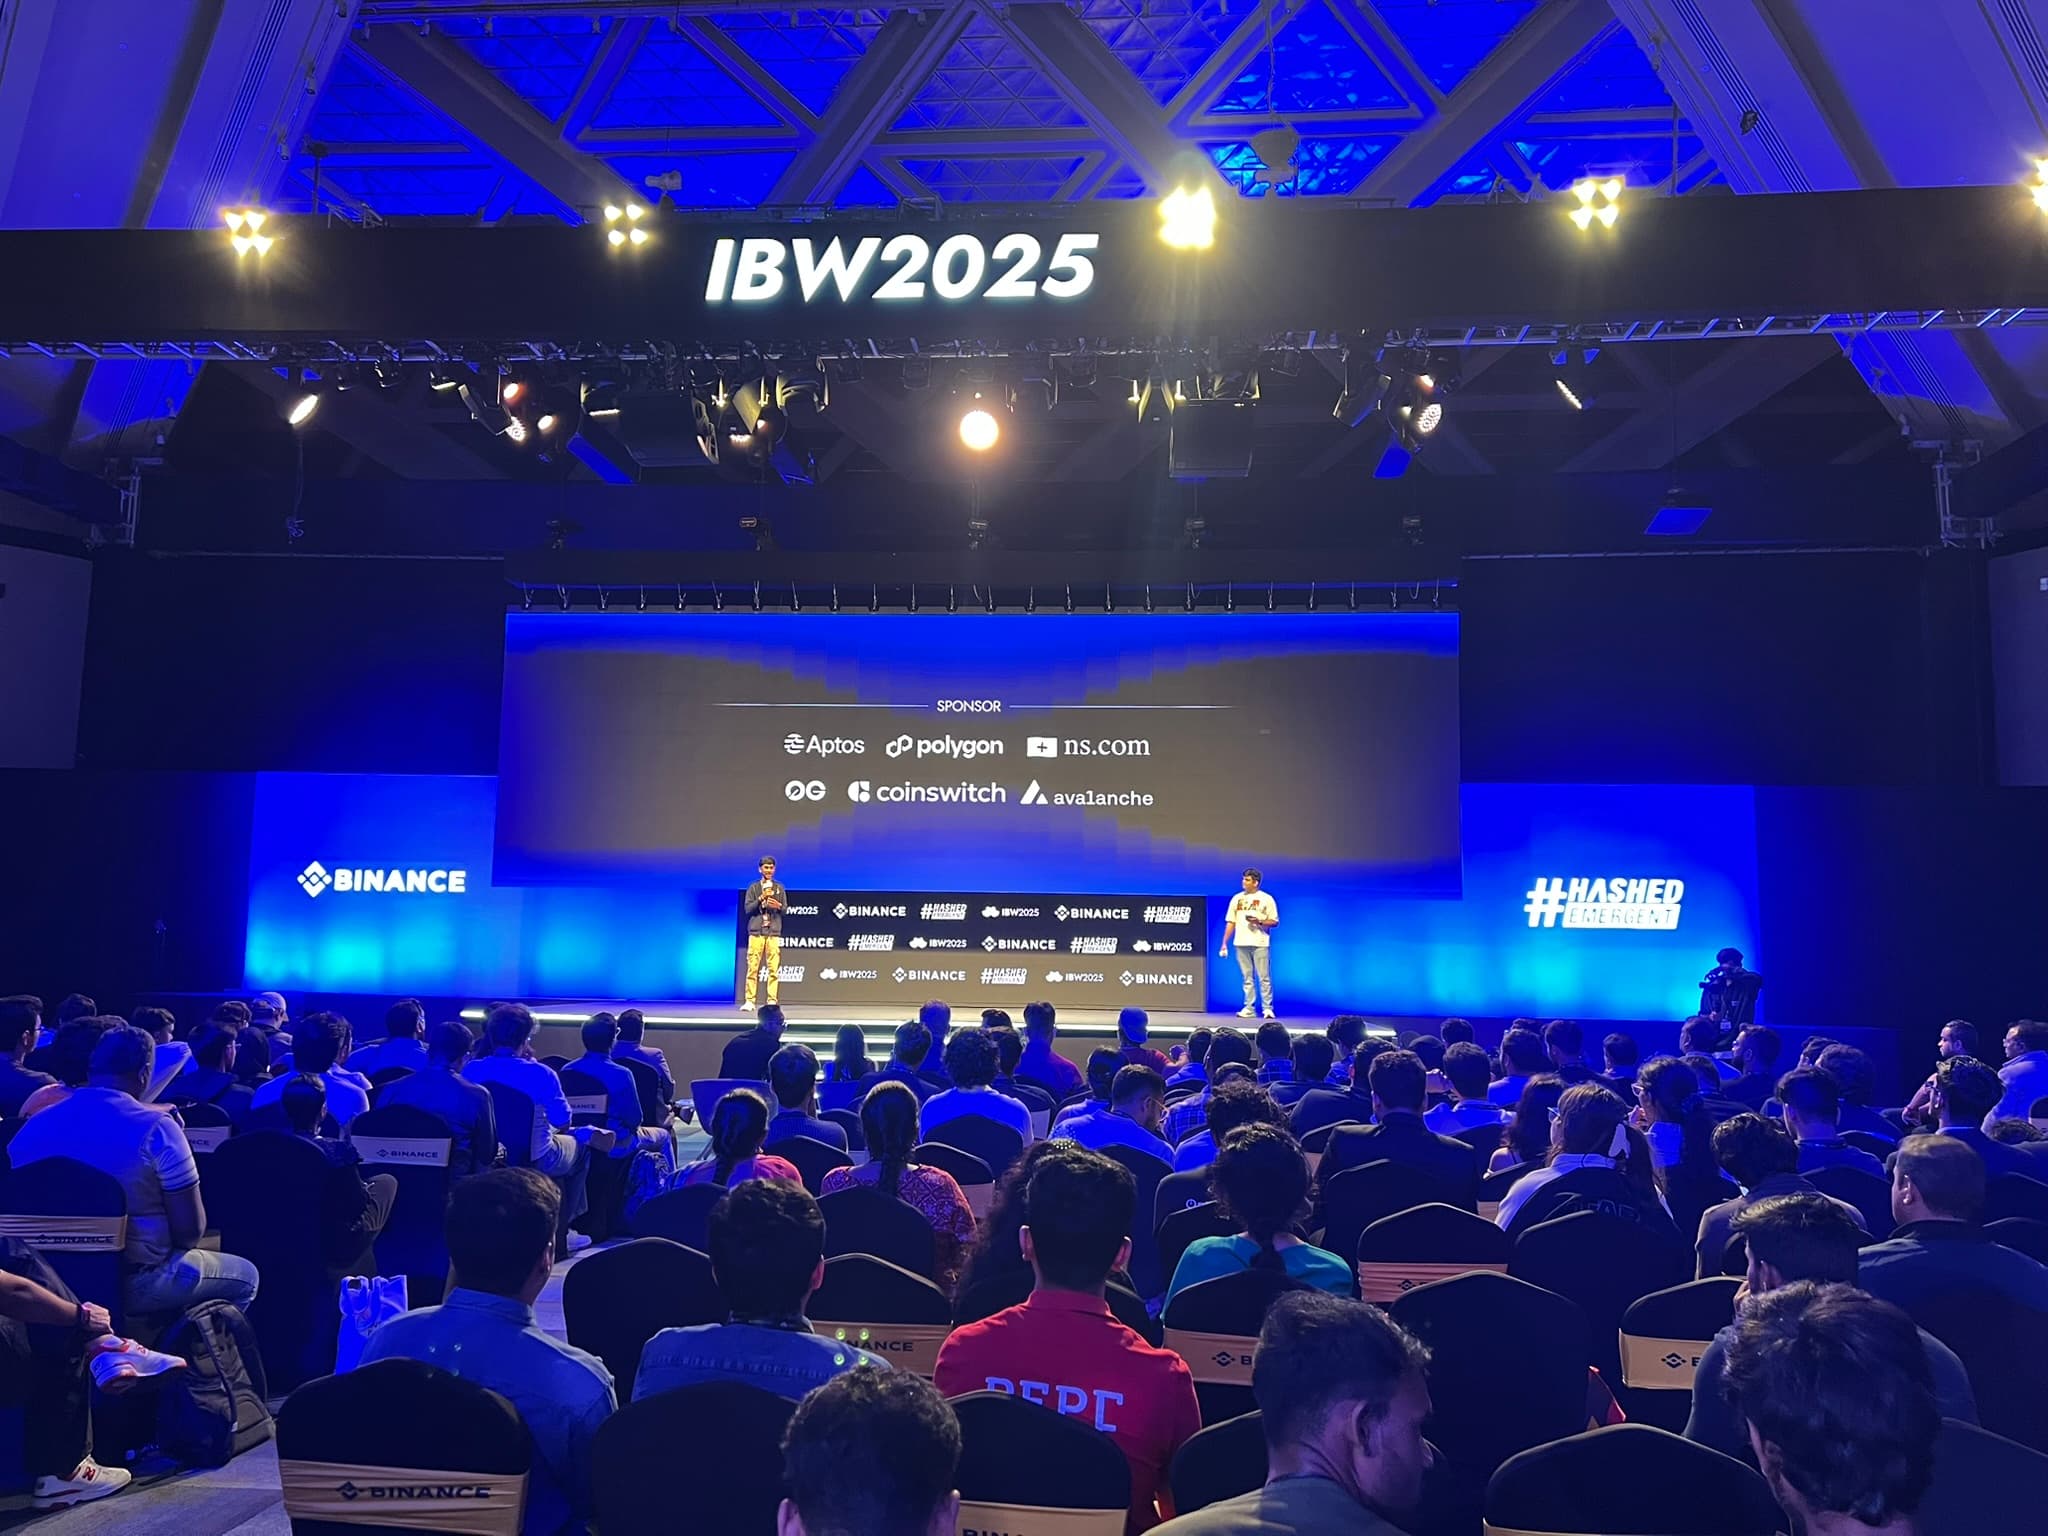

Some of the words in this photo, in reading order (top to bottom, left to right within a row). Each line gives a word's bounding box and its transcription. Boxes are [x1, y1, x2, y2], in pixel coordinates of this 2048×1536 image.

[705, 233, 1100, 303] IBW2025
[937, 700, 1001, 713] SPONSOR
[805, 734, 865, 758] Aptos
[917, 734, 1004, 759] polygon
[1064, 738, 1151, 756] ns.com
[876, 781, 1006, 803] coinswitch
[1053, 789, 1154, 806] avalanche
[333, 869, 467, 893] BINANCE
[849, 906, 907, 917] BINANCE
[1001, 907, 1040, 917] IBW2025
[1070, 908, 1130, 920] BINANCE
[1566, 906, 1676, 927] EMERGENT
[929, 938, 968, 949] IBW2025
[998, 939, 1057, 950] BINANCE
[1153, 942, 1193, 952] IBW2025
[839, 970, 878, 979] IBW2025
[908, 970, 966, 981] BINANCE
[1065, 973, 1104, 983] IBW2025
[1135, 973, 1193, 985] BINANCE
[389, 1150, 439, 1159] BINANCE
[370, 1486, 491, 1499] BINANCE
